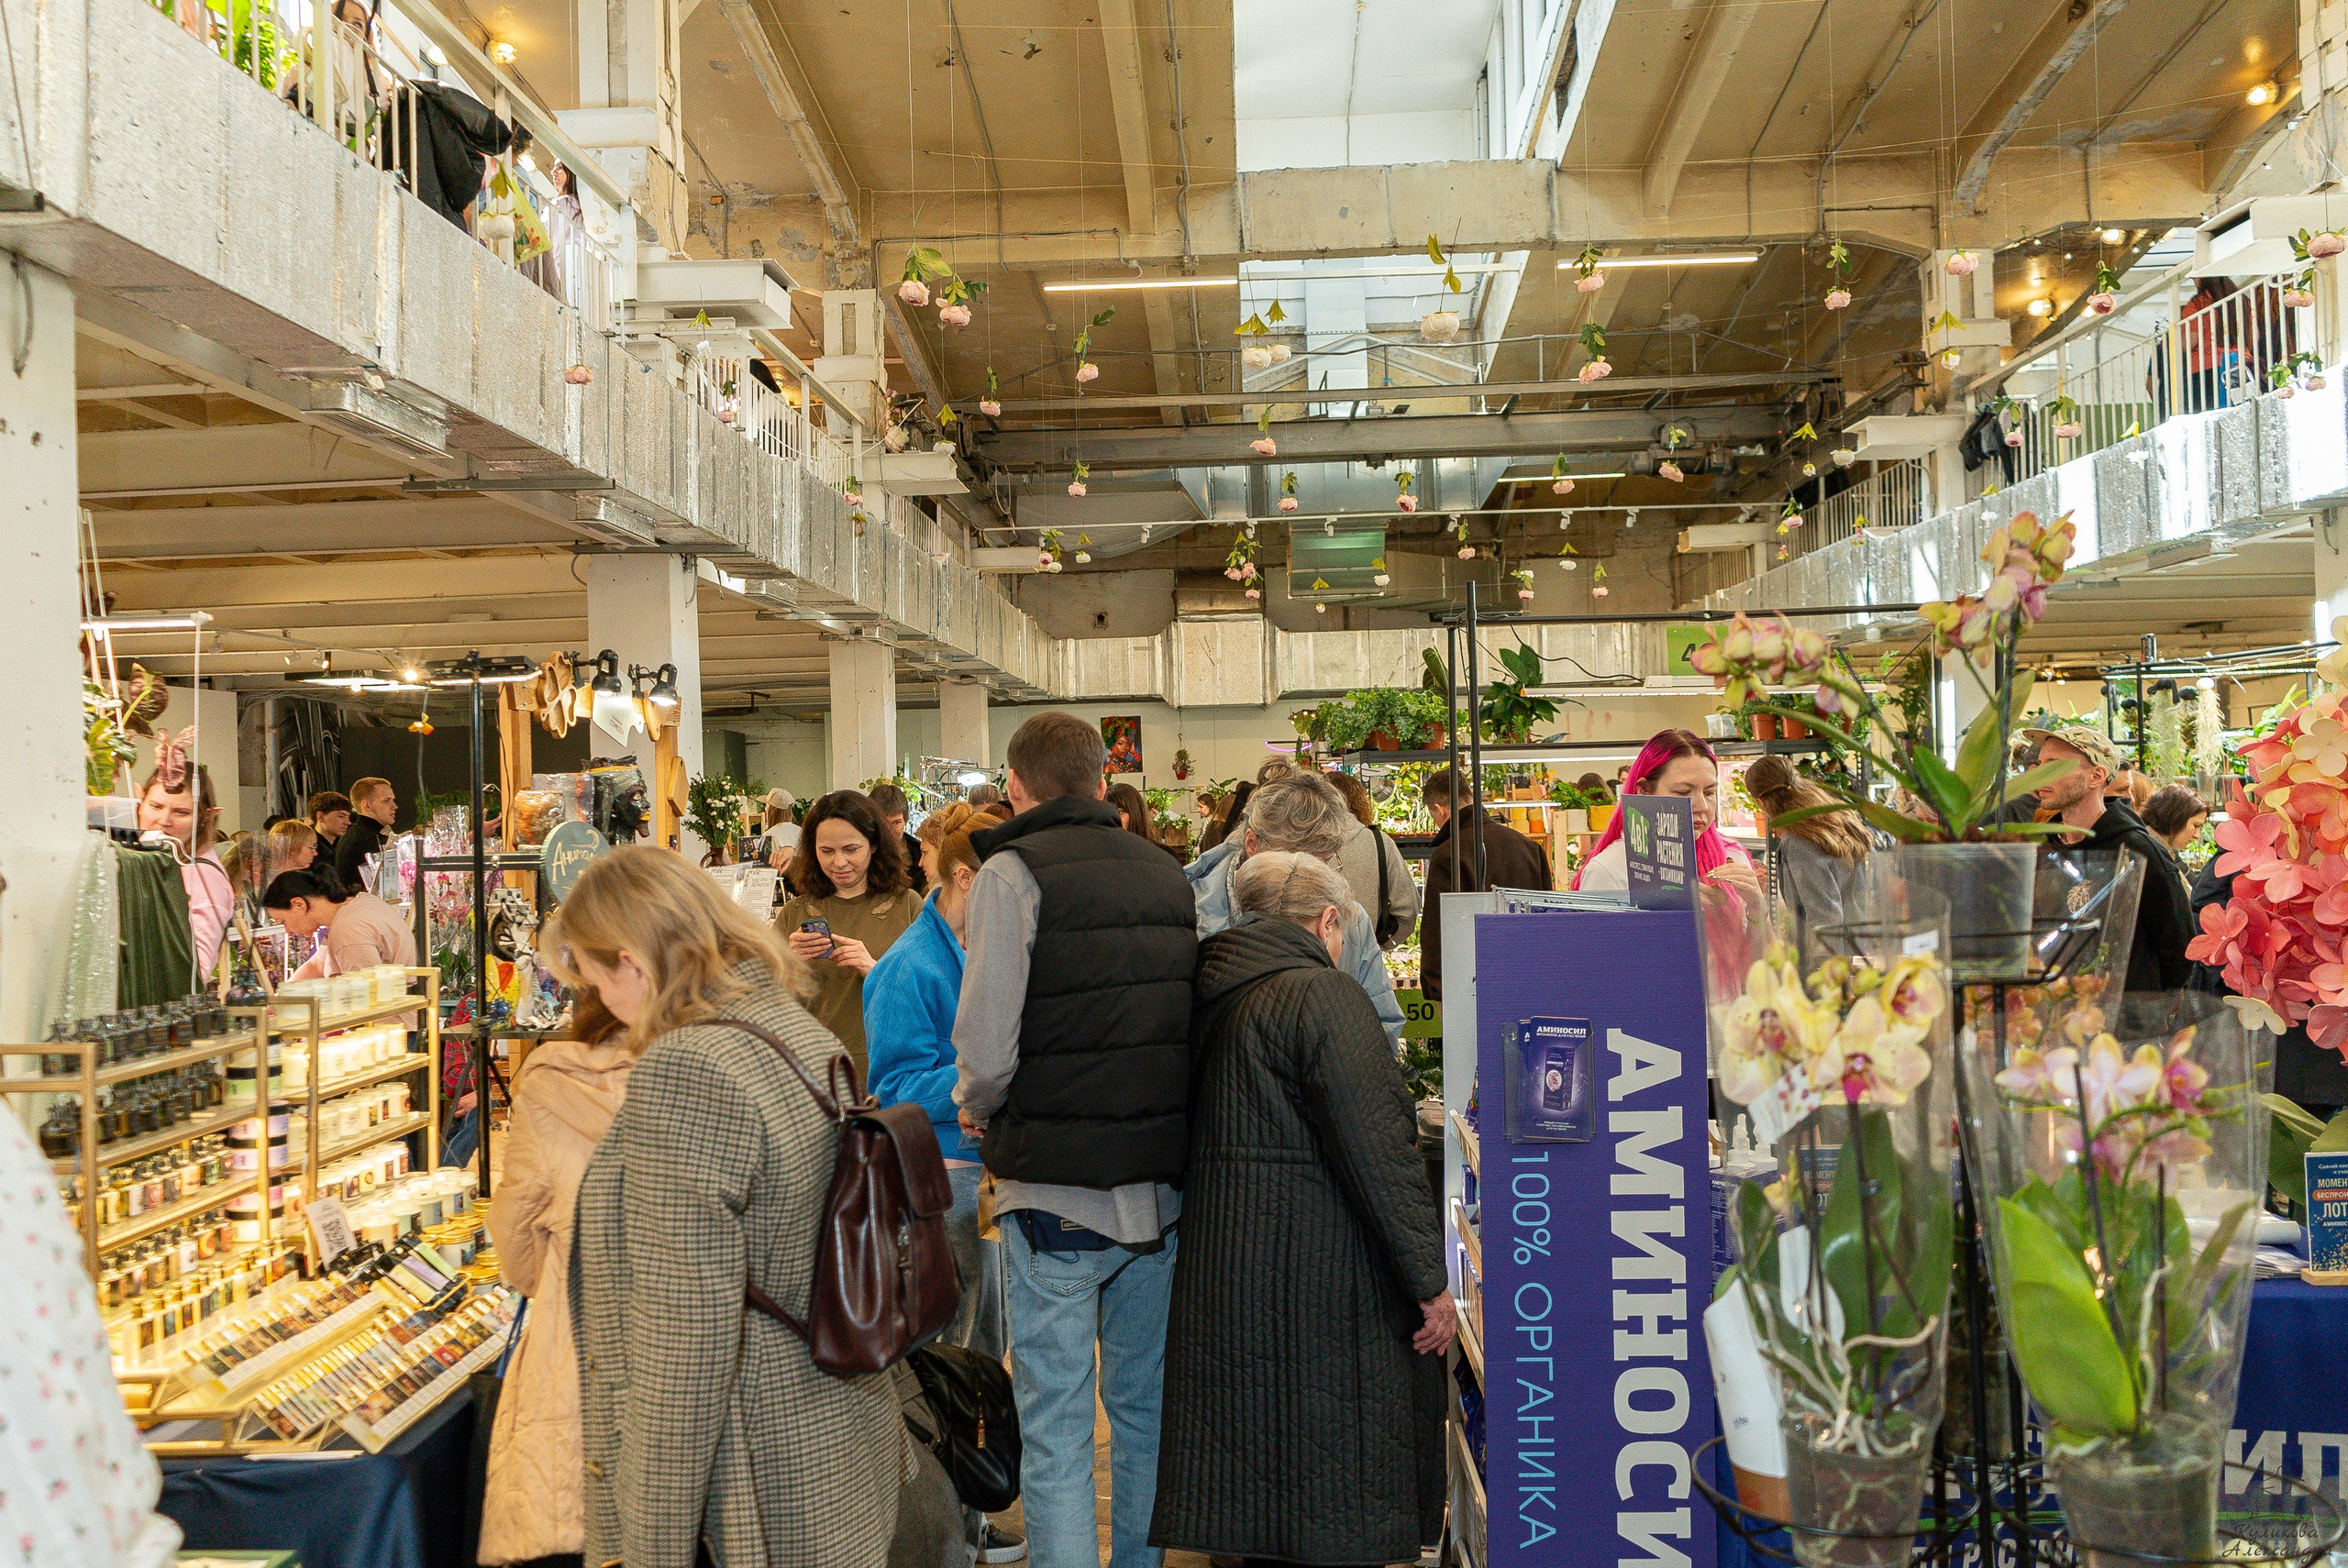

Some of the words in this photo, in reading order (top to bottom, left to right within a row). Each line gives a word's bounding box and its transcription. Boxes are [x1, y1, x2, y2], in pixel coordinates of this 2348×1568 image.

[1656, 839, 1684, 867] РАСТЕНИЯ
[1407, 1002, 1434, 1021] 50
[1536, 1026, 1587, 1034] АМИНОСИЛ
[1512, 1151, 1551, 1265] 100%
[2322, 1202, 2348, 1218] ЛОТ
[1514, 1282, 1556, 1549] ОРГАНИКА
